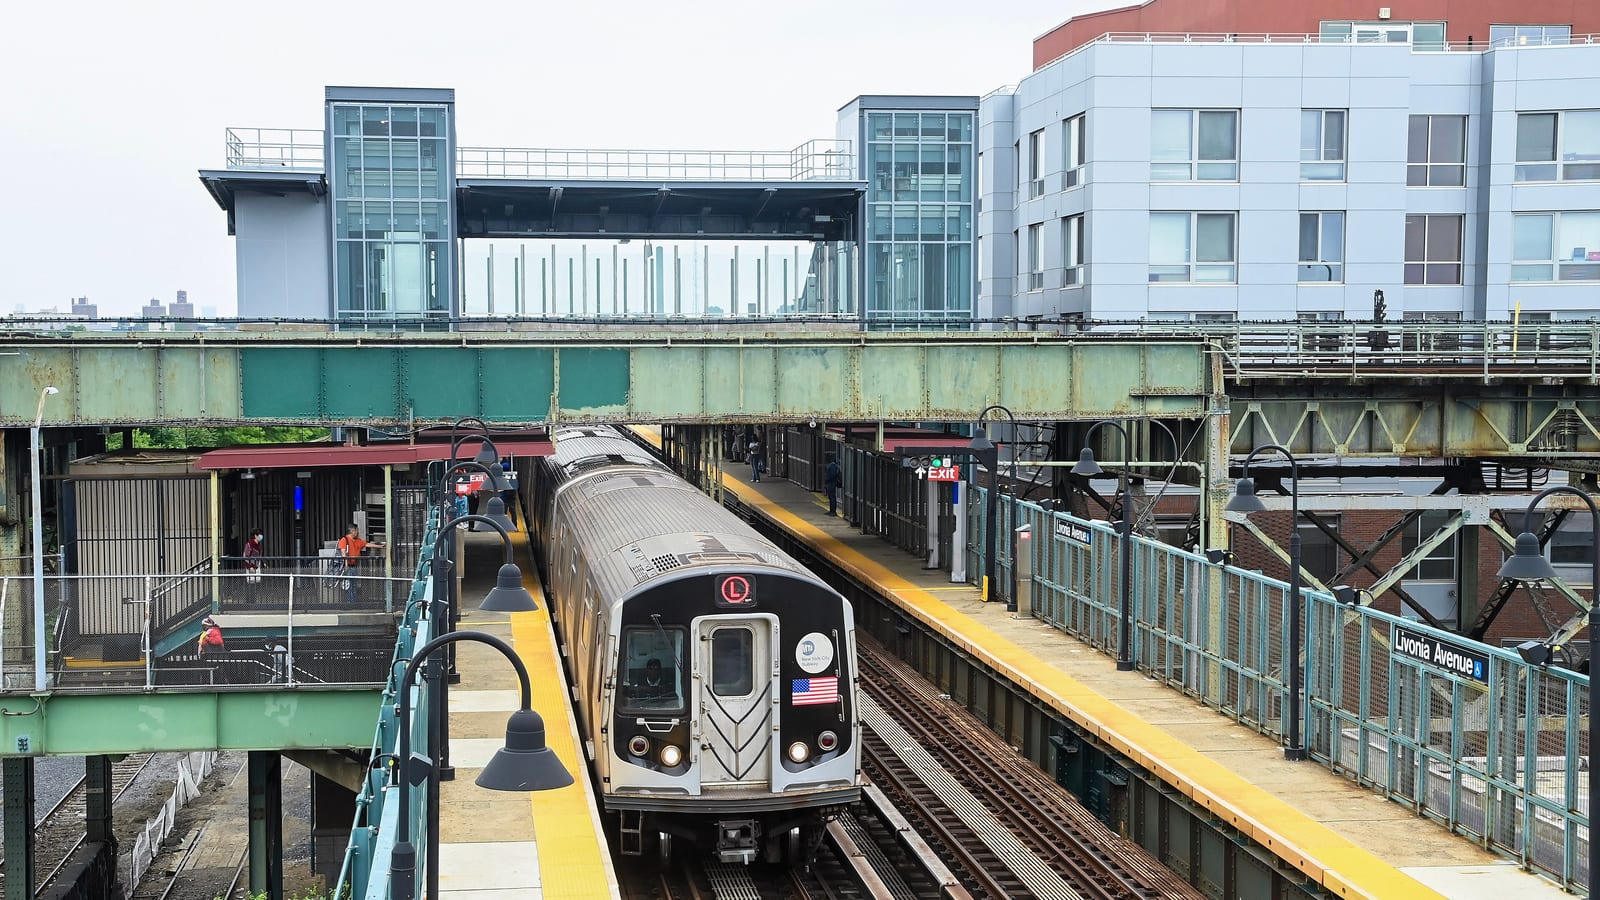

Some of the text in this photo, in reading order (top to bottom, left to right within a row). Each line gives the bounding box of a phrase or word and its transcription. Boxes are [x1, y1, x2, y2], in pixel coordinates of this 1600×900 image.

[928, 466, 955, 479] Exit
[1395, 629, 1474, 675] Livonia Avenue
